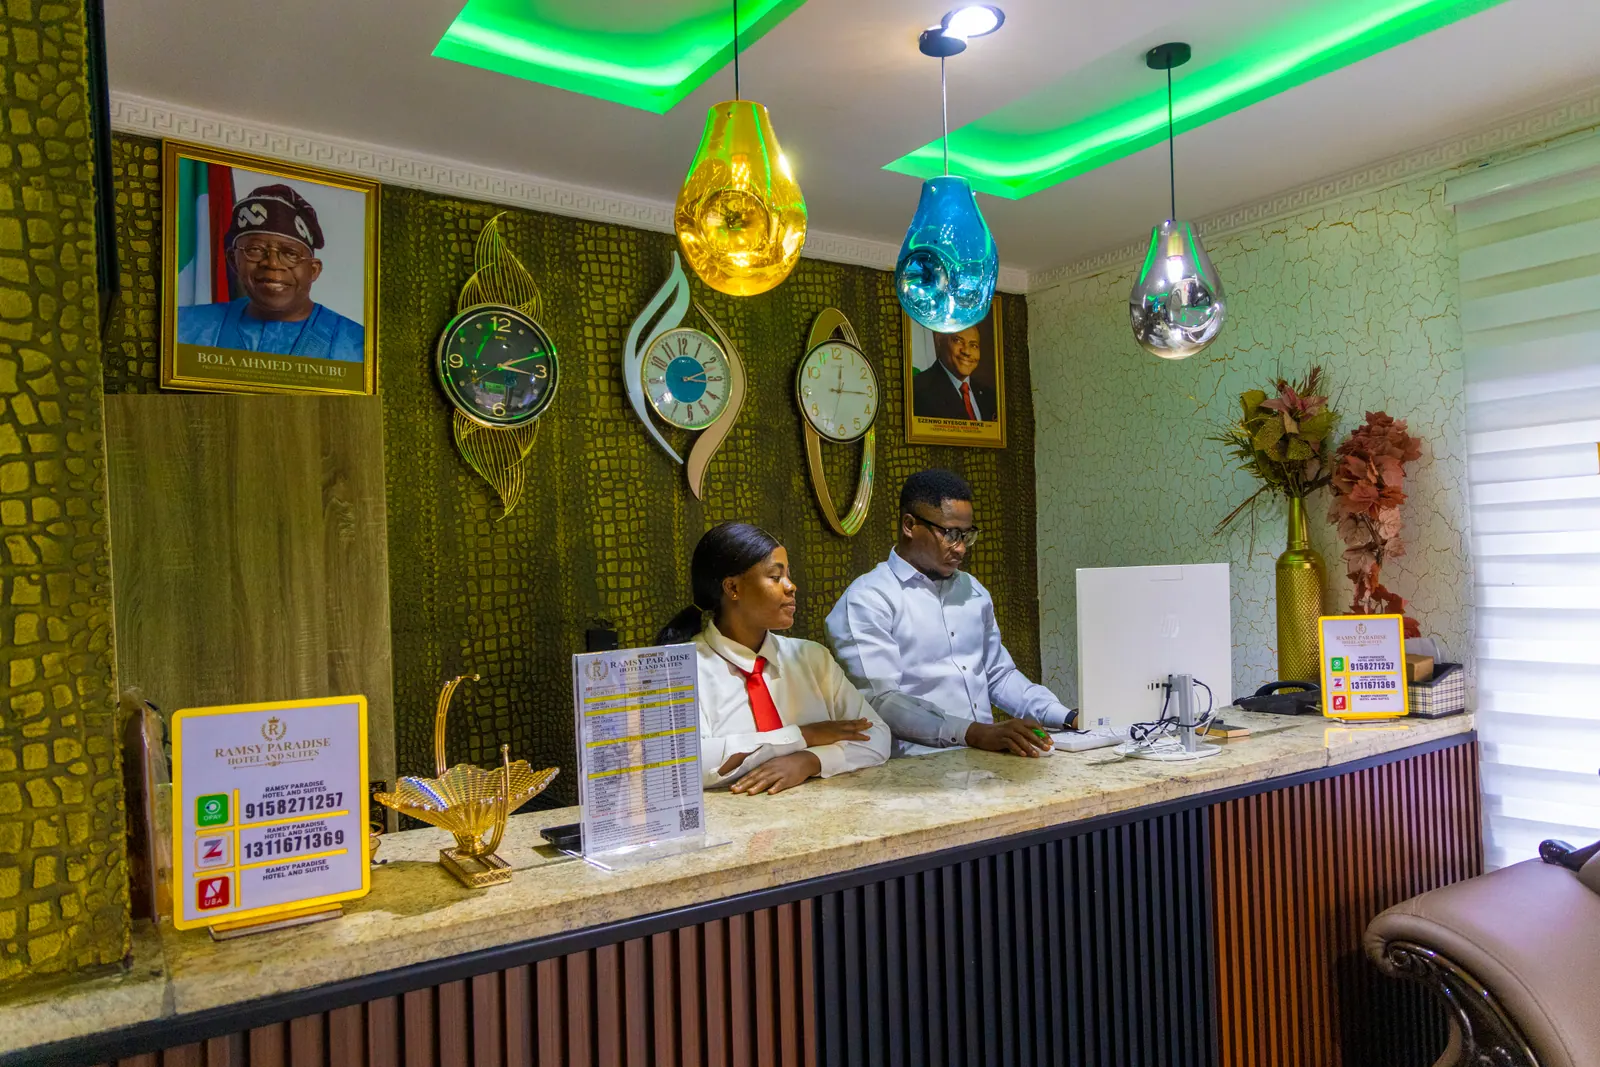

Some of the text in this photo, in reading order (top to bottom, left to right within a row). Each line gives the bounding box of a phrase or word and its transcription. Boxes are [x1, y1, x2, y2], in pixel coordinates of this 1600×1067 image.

[490, 316, 512, 333] 12
[662, 342, 675, 360] 11
[678, 338, 688, 355] 12
[694, 343, 702, 358] 1
[818, 352, 826, 365] 11
[831, 348, 842, 360] 12
[850, 353, 854, 365] 1
[197, 352, 236, 366] BOLA
[240, 358, 292, 372] AHMED
[294, 363, 347, 377] TINUBU
[449, 354, 463, 368] 9
[535, 365, 547, 378] 3
[807, 366, 821, 379] 10
[860, 368, 868, 379] 2
[867, 386, 873, 398] 3
[493, 402, 506, 417] 6
[610, 654, 690, 668] RAMSY PARADISE
[1351, 662, 1394, 671] 9158271257
[593, 665, 601, 677] R
[1351, 681, 1396, 689] 1311671369
[269, 724, 278, 736] R
[215, 737, 331, 758] RAMSY PARADISE
[228, 749, 320, 765] HOTEL AND SUITES
[265, 780, 324, 792] RAMSY PARADISE
[303, 786, 327, 794] SUITES
[245, 792, 343, 819] 9158271257
[267, 820, 325, 833] RAMSY PARADISE
[304, 826, 328, 834] SUITES
[203, 839, 223, 859] Z
[244, 830, 344, 859] 1311671369
[266, 859, 327, 874] RAMSY PARADISE
[305, 865, 330, 874] SUITES
[204, 898, 223, 906] UBA
